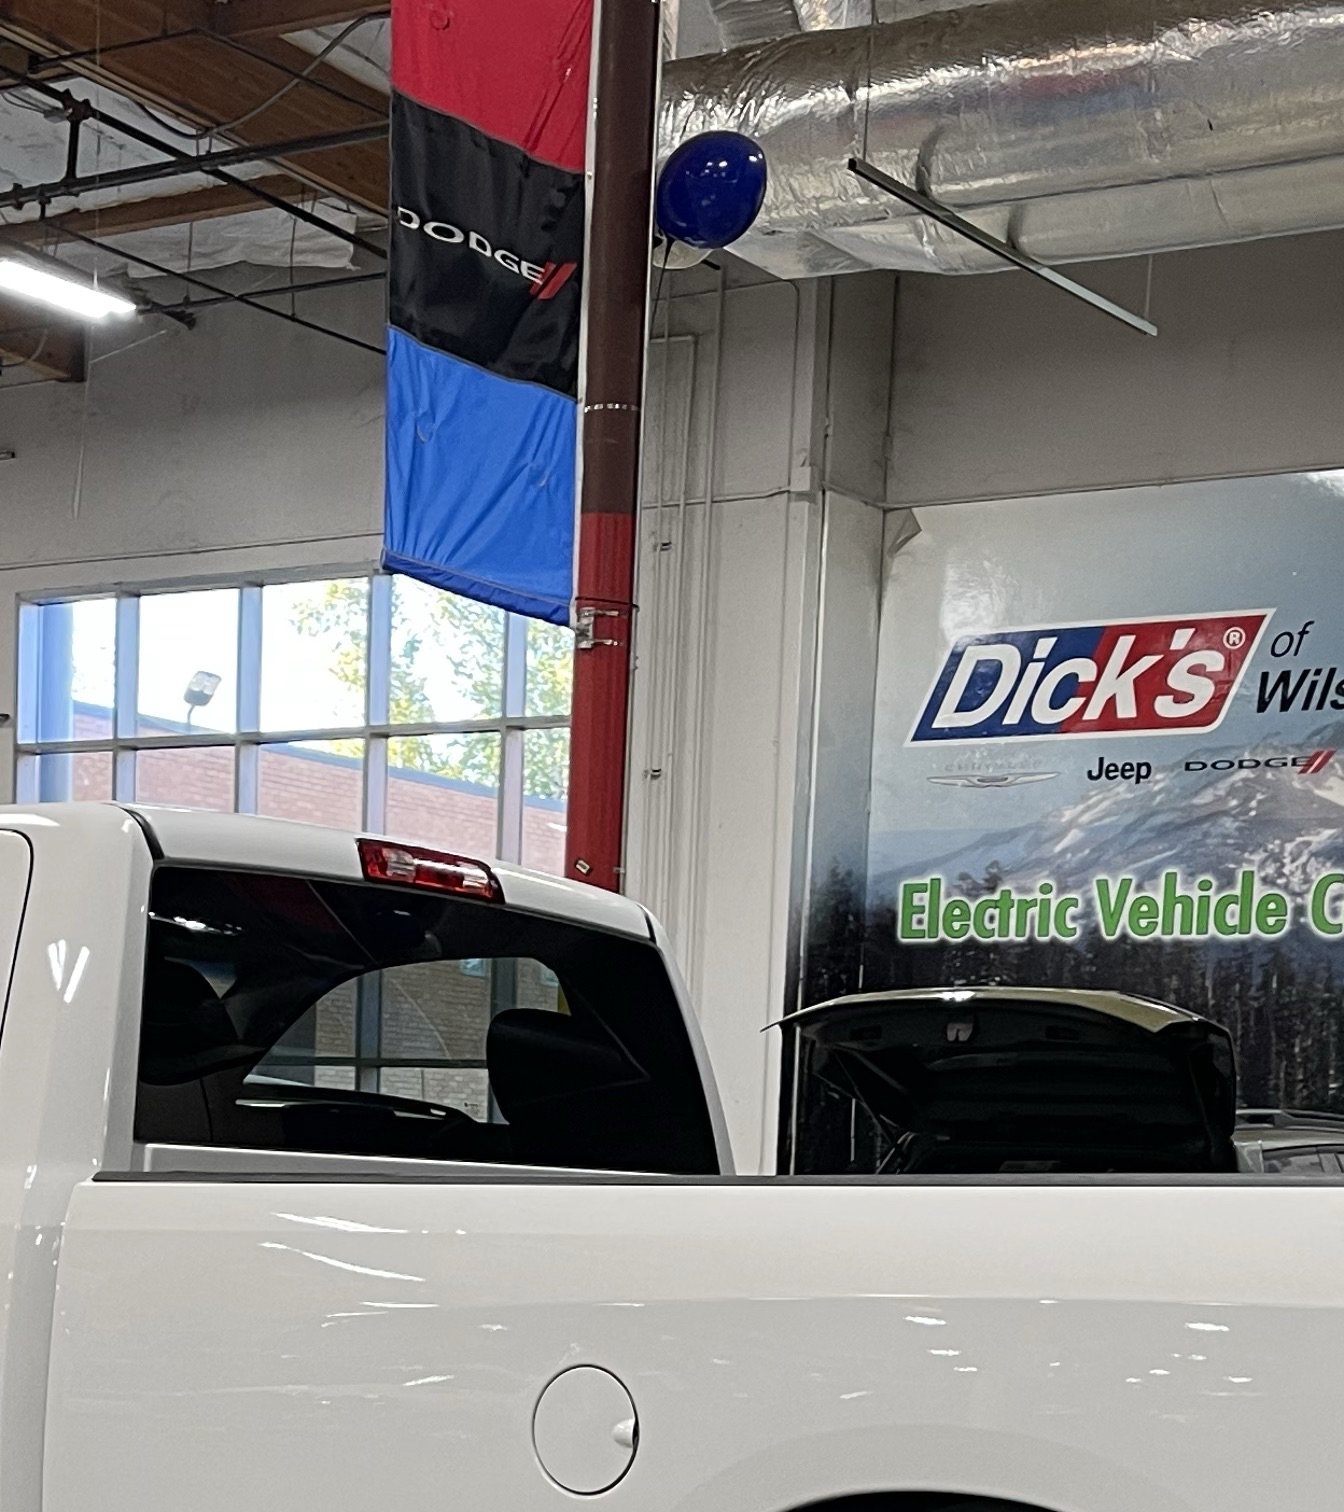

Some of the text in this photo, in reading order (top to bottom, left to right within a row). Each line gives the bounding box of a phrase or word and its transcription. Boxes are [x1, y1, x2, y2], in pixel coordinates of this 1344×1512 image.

[397, 206, 546, 285] DODGE
[1270, 621, 1315, 658] of
[931, 628, 1226, 729] Dick's
[1087, 757, 1153, 785] Jeep
[1184, 755, 1312, 772] DODGE
[900, 877, 1080, 939] Electric
[1096, 870, 1289, 937] Vehicle
